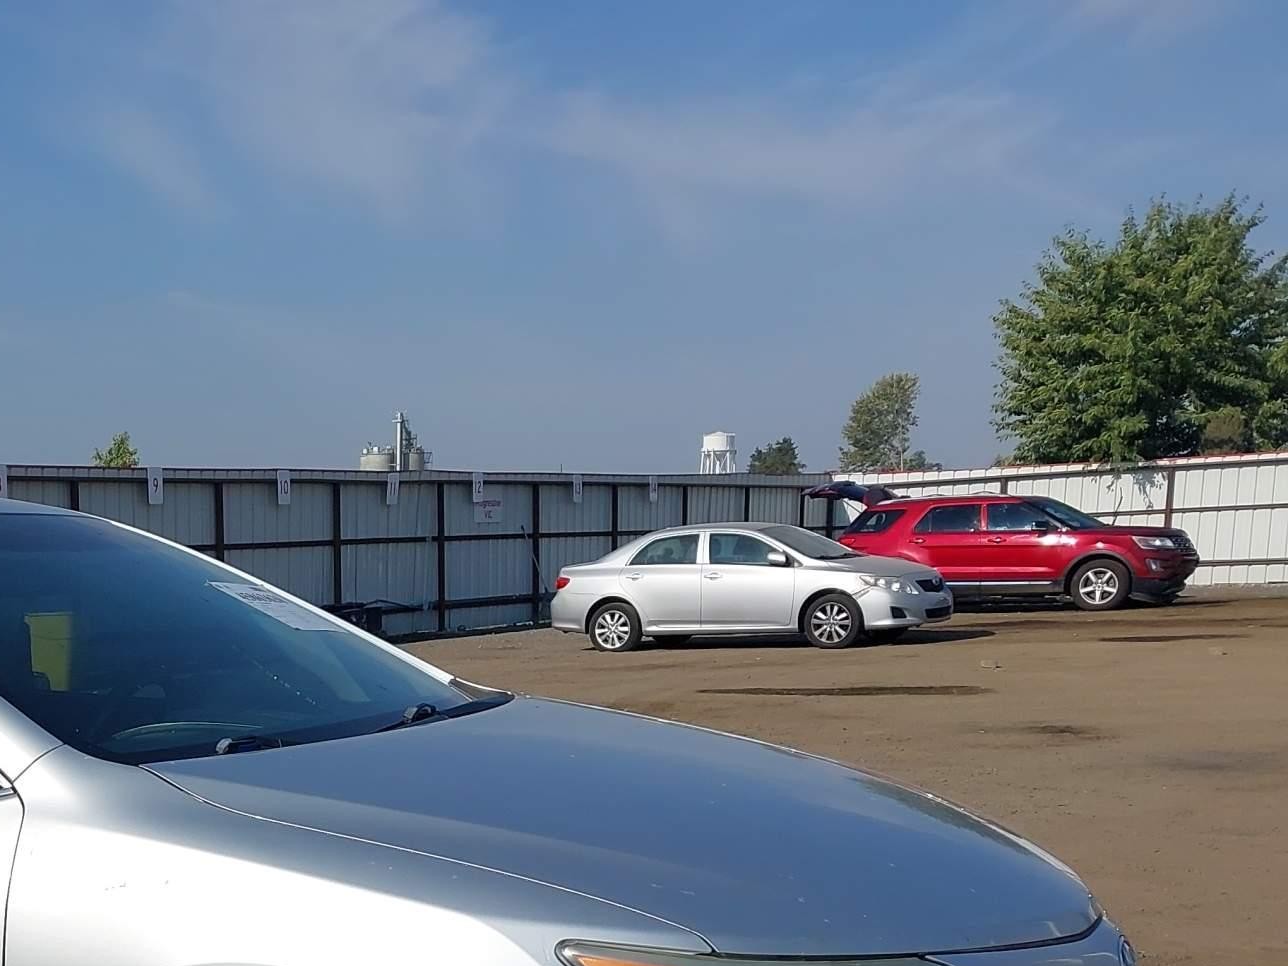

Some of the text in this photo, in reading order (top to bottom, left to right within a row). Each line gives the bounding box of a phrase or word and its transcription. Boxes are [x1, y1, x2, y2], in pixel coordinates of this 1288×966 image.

[152, 477, 159, 495] 9
[279, 480, 289, 495] 10
[474, 480, 482, 494] 12
